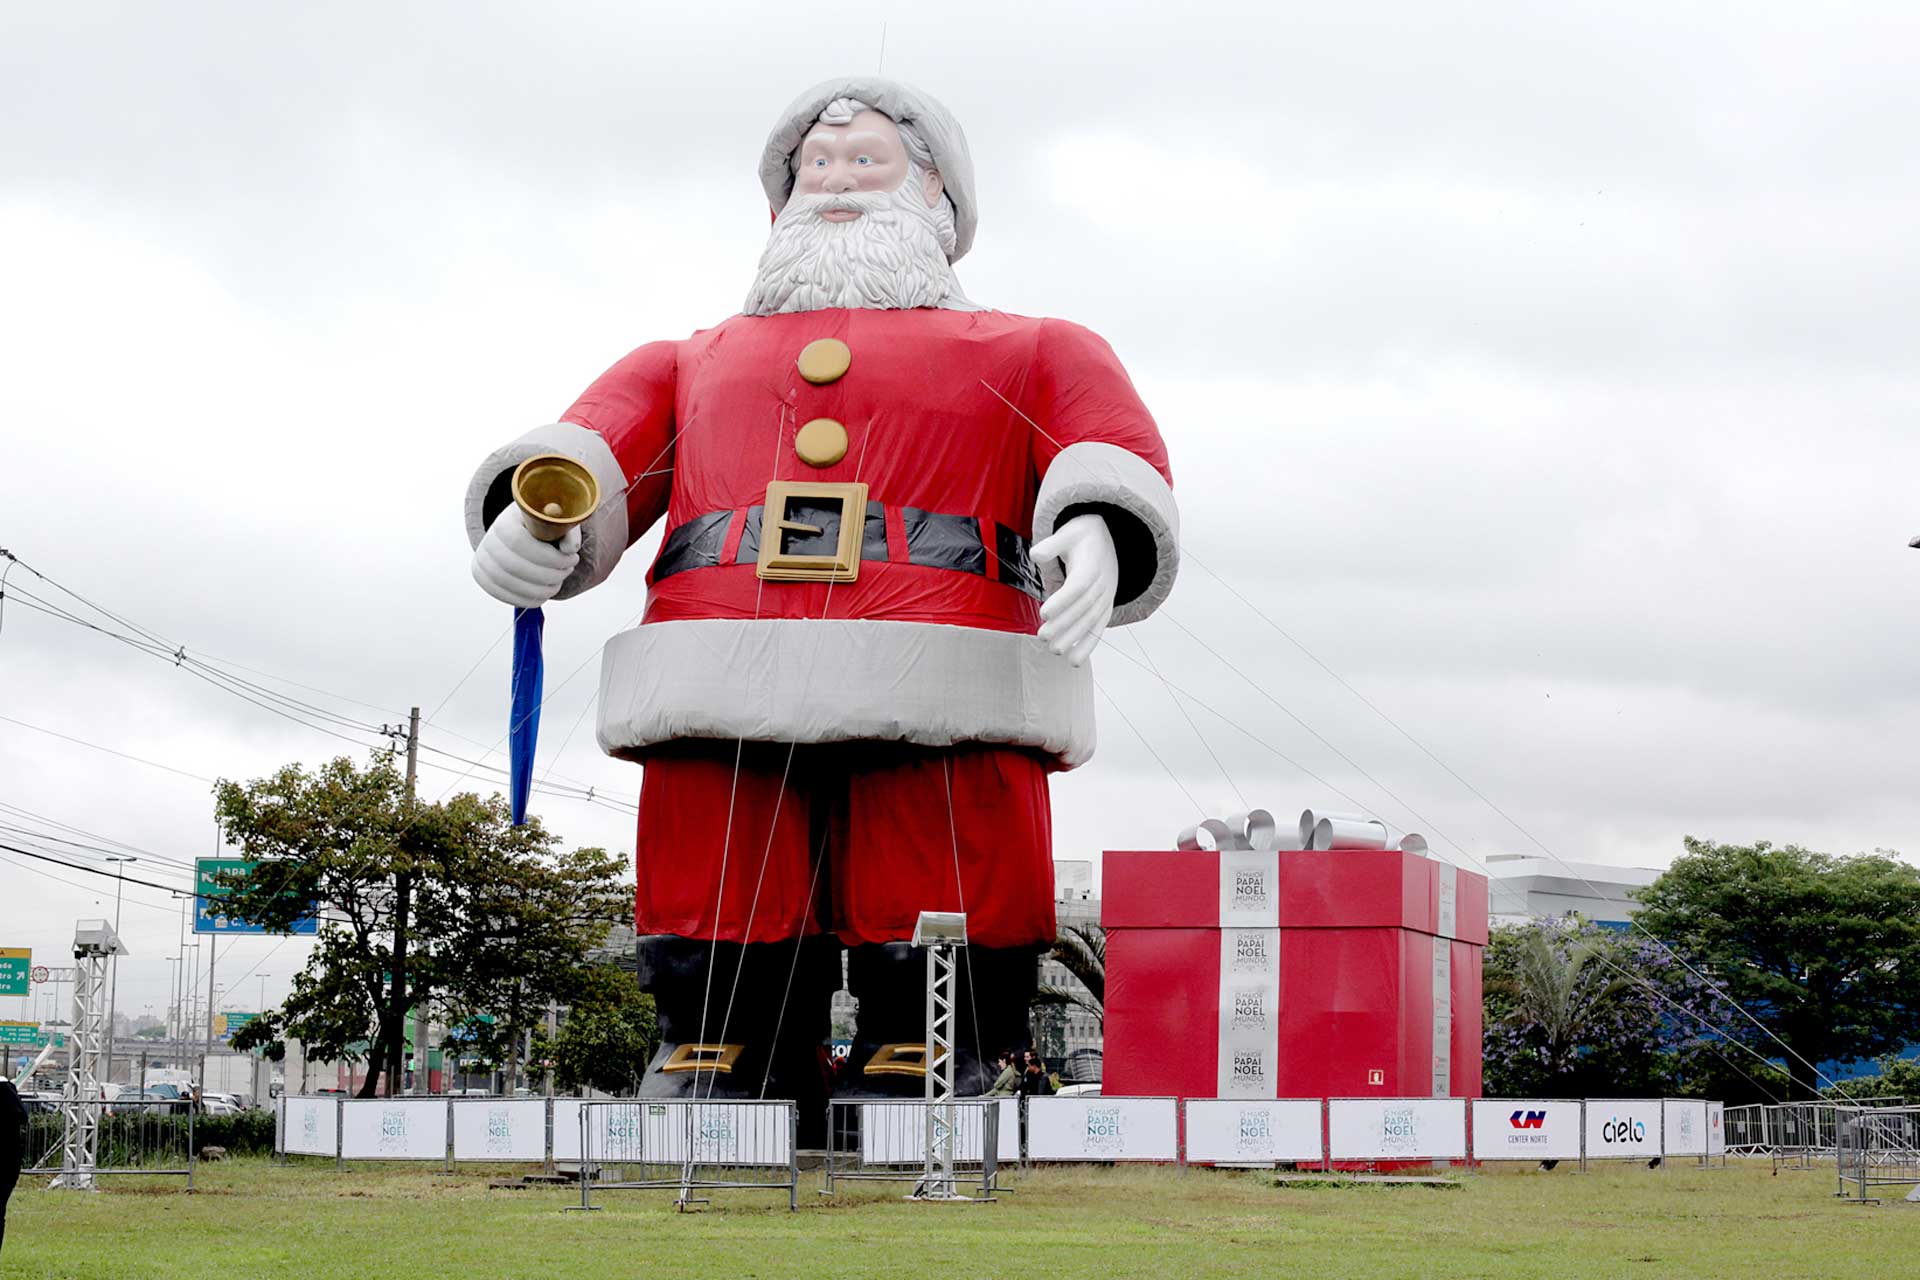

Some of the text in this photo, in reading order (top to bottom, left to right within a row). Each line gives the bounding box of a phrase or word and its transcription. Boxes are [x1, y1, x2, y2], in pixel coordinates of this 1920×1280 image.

[1236, 886, 1266, 894] NOEL
[1237, 948, 1266, 956] NOEL
[1236, 1007, 1264, 1016] NOEL
[1234, 1066, 1264, 1074] NOEL
[1088, 1116, 1119, 1124] PAPAI
[1240, 1118, 1268, 1126] PAPAI
[1384, 1116, 1412, 1125] PAPAI
[383, 1126, 408, 1136] NOEL
[489, 1127, 511, 1136] NOEL
[609, 1128, 640, 1137] NOEL
[1088, 1126, 1122, 1135] NOEL
[1241, 1128, 1272, 1137] NOEL
[1384, 1126, 1416, 1136] NOEL
[1602, 1115, 1646, 1142] cielo
[701, 1130, 734, 1139] NOEL
[1508, 1135, 1548, 1144] CENTER NORTE
